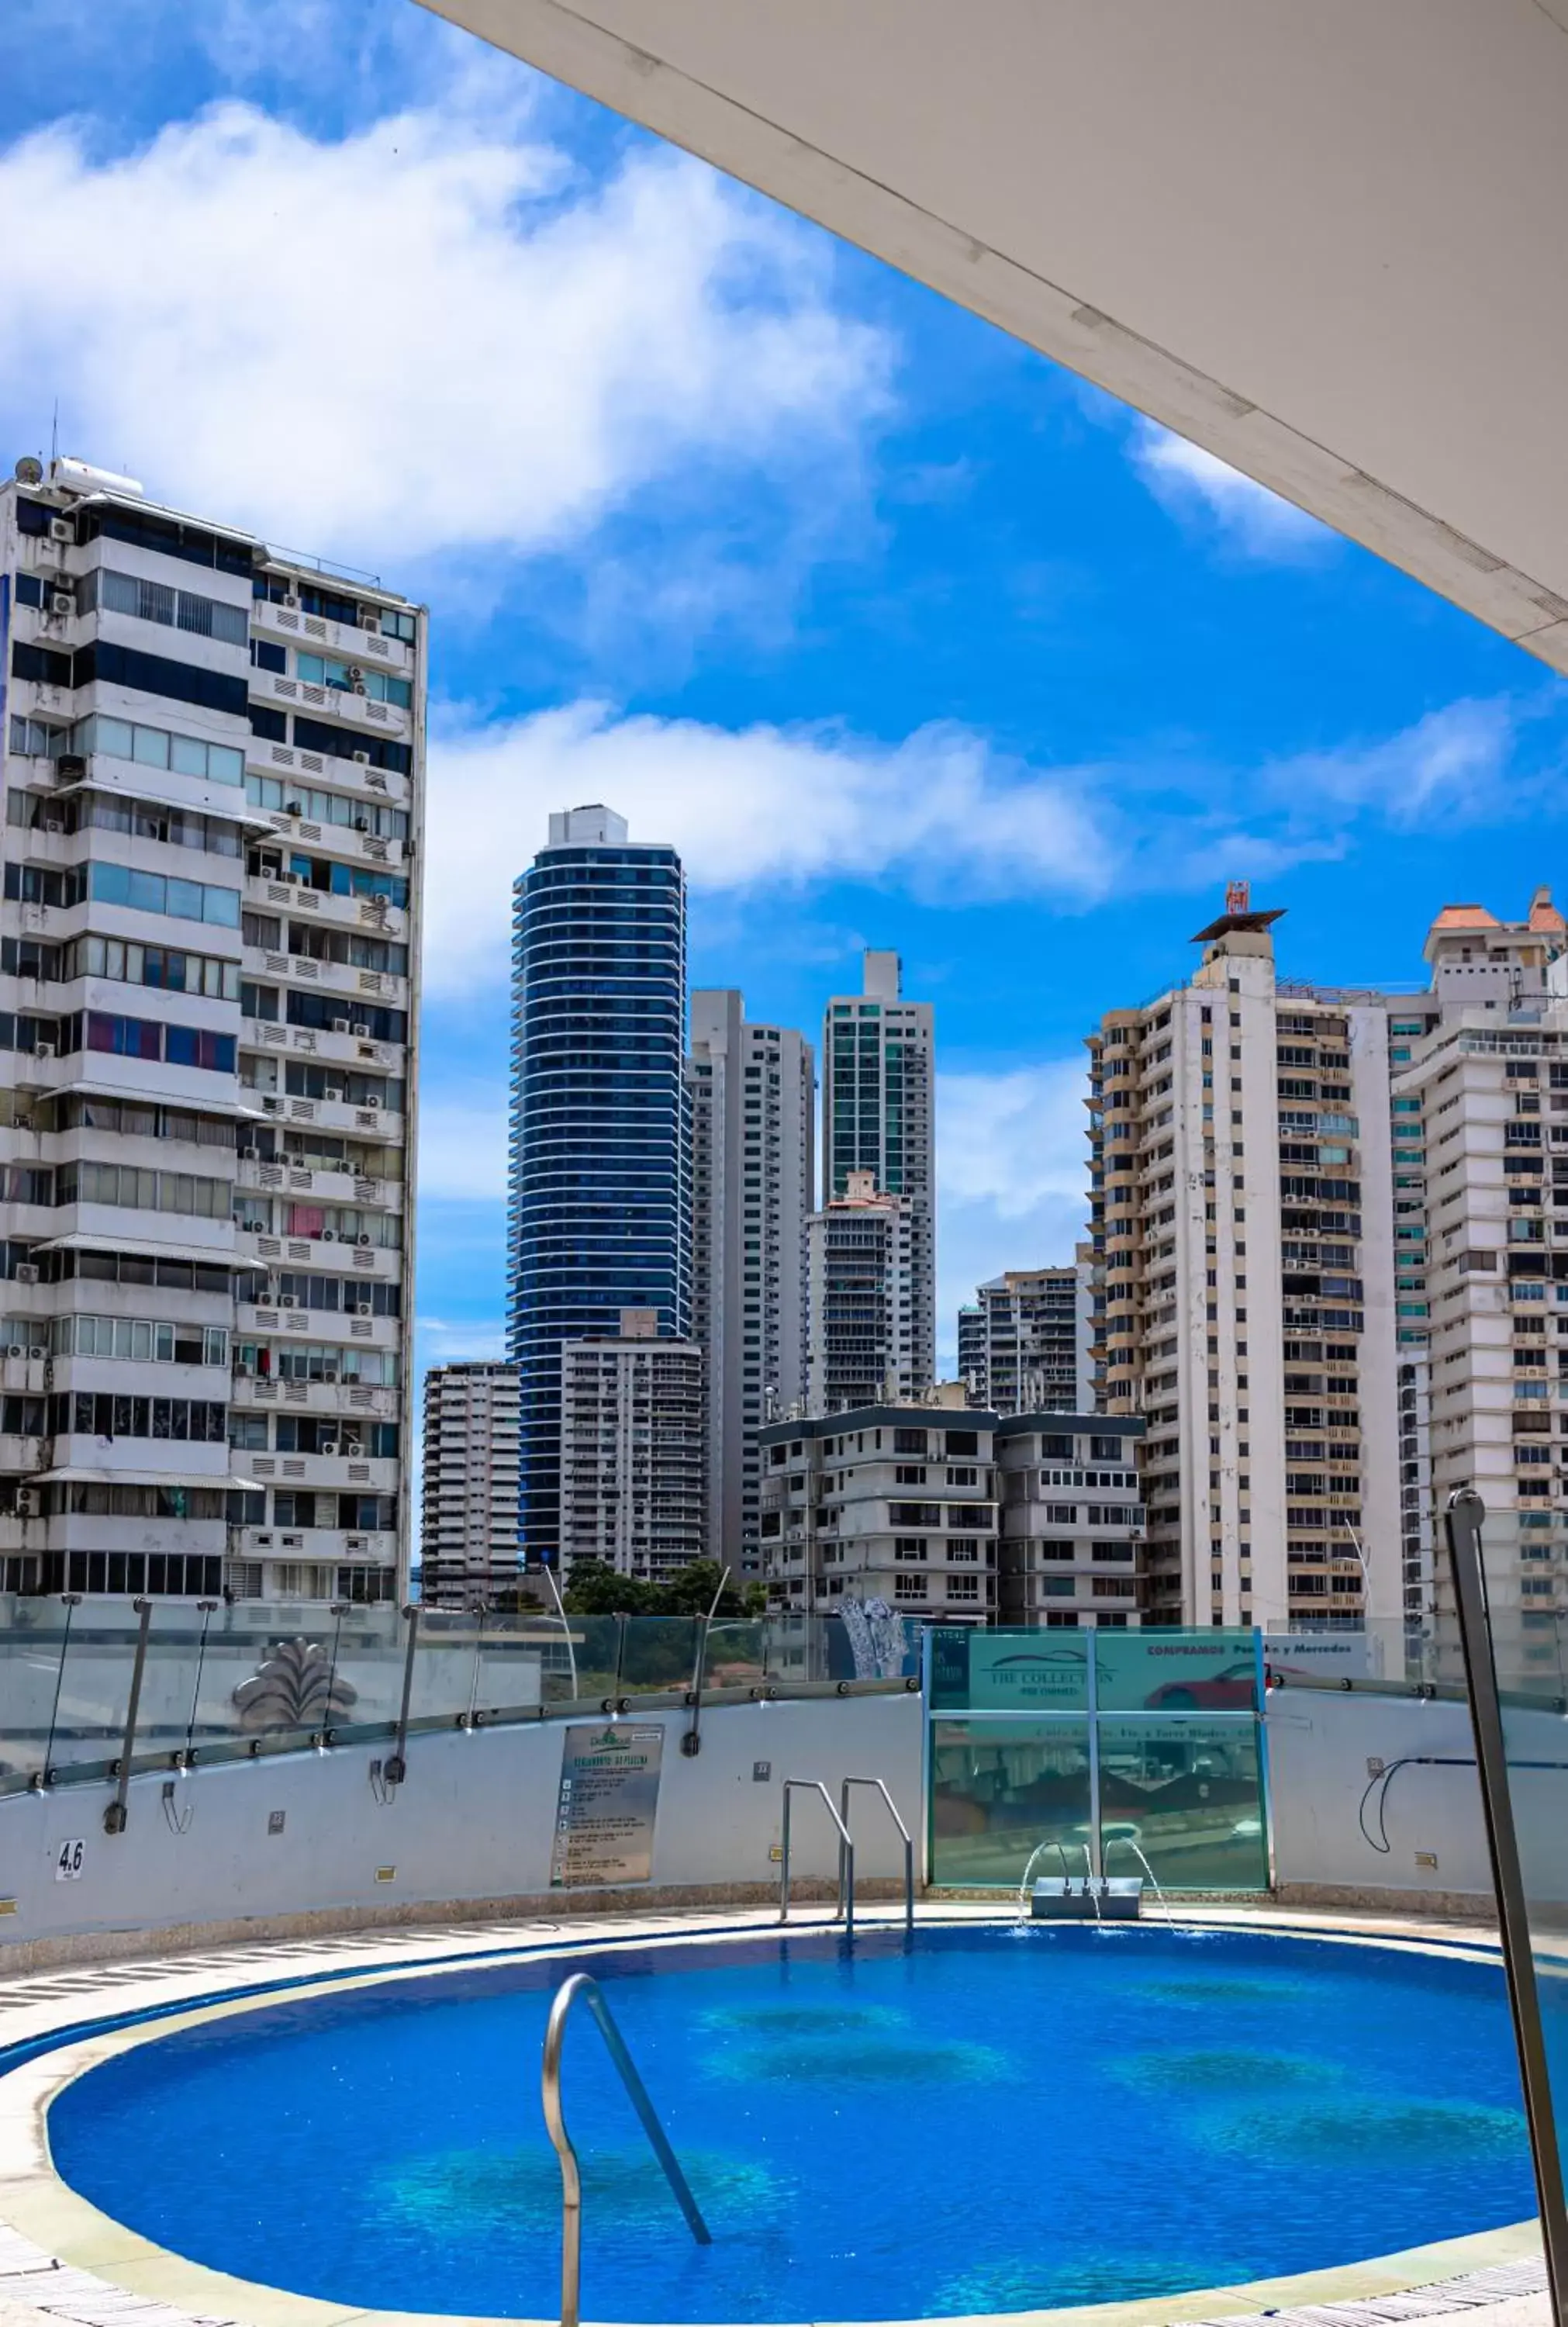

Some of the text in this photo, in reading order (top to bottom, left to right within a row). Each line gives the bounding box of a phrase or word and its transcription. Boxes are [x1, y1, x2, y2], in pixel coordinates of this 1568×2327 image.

[1293, 1643, 1352, 1654] Mercedes
[992, 1672, 1114, 1685] THE COLLECTN
[59, 1841, 83, 1872] 4.6
